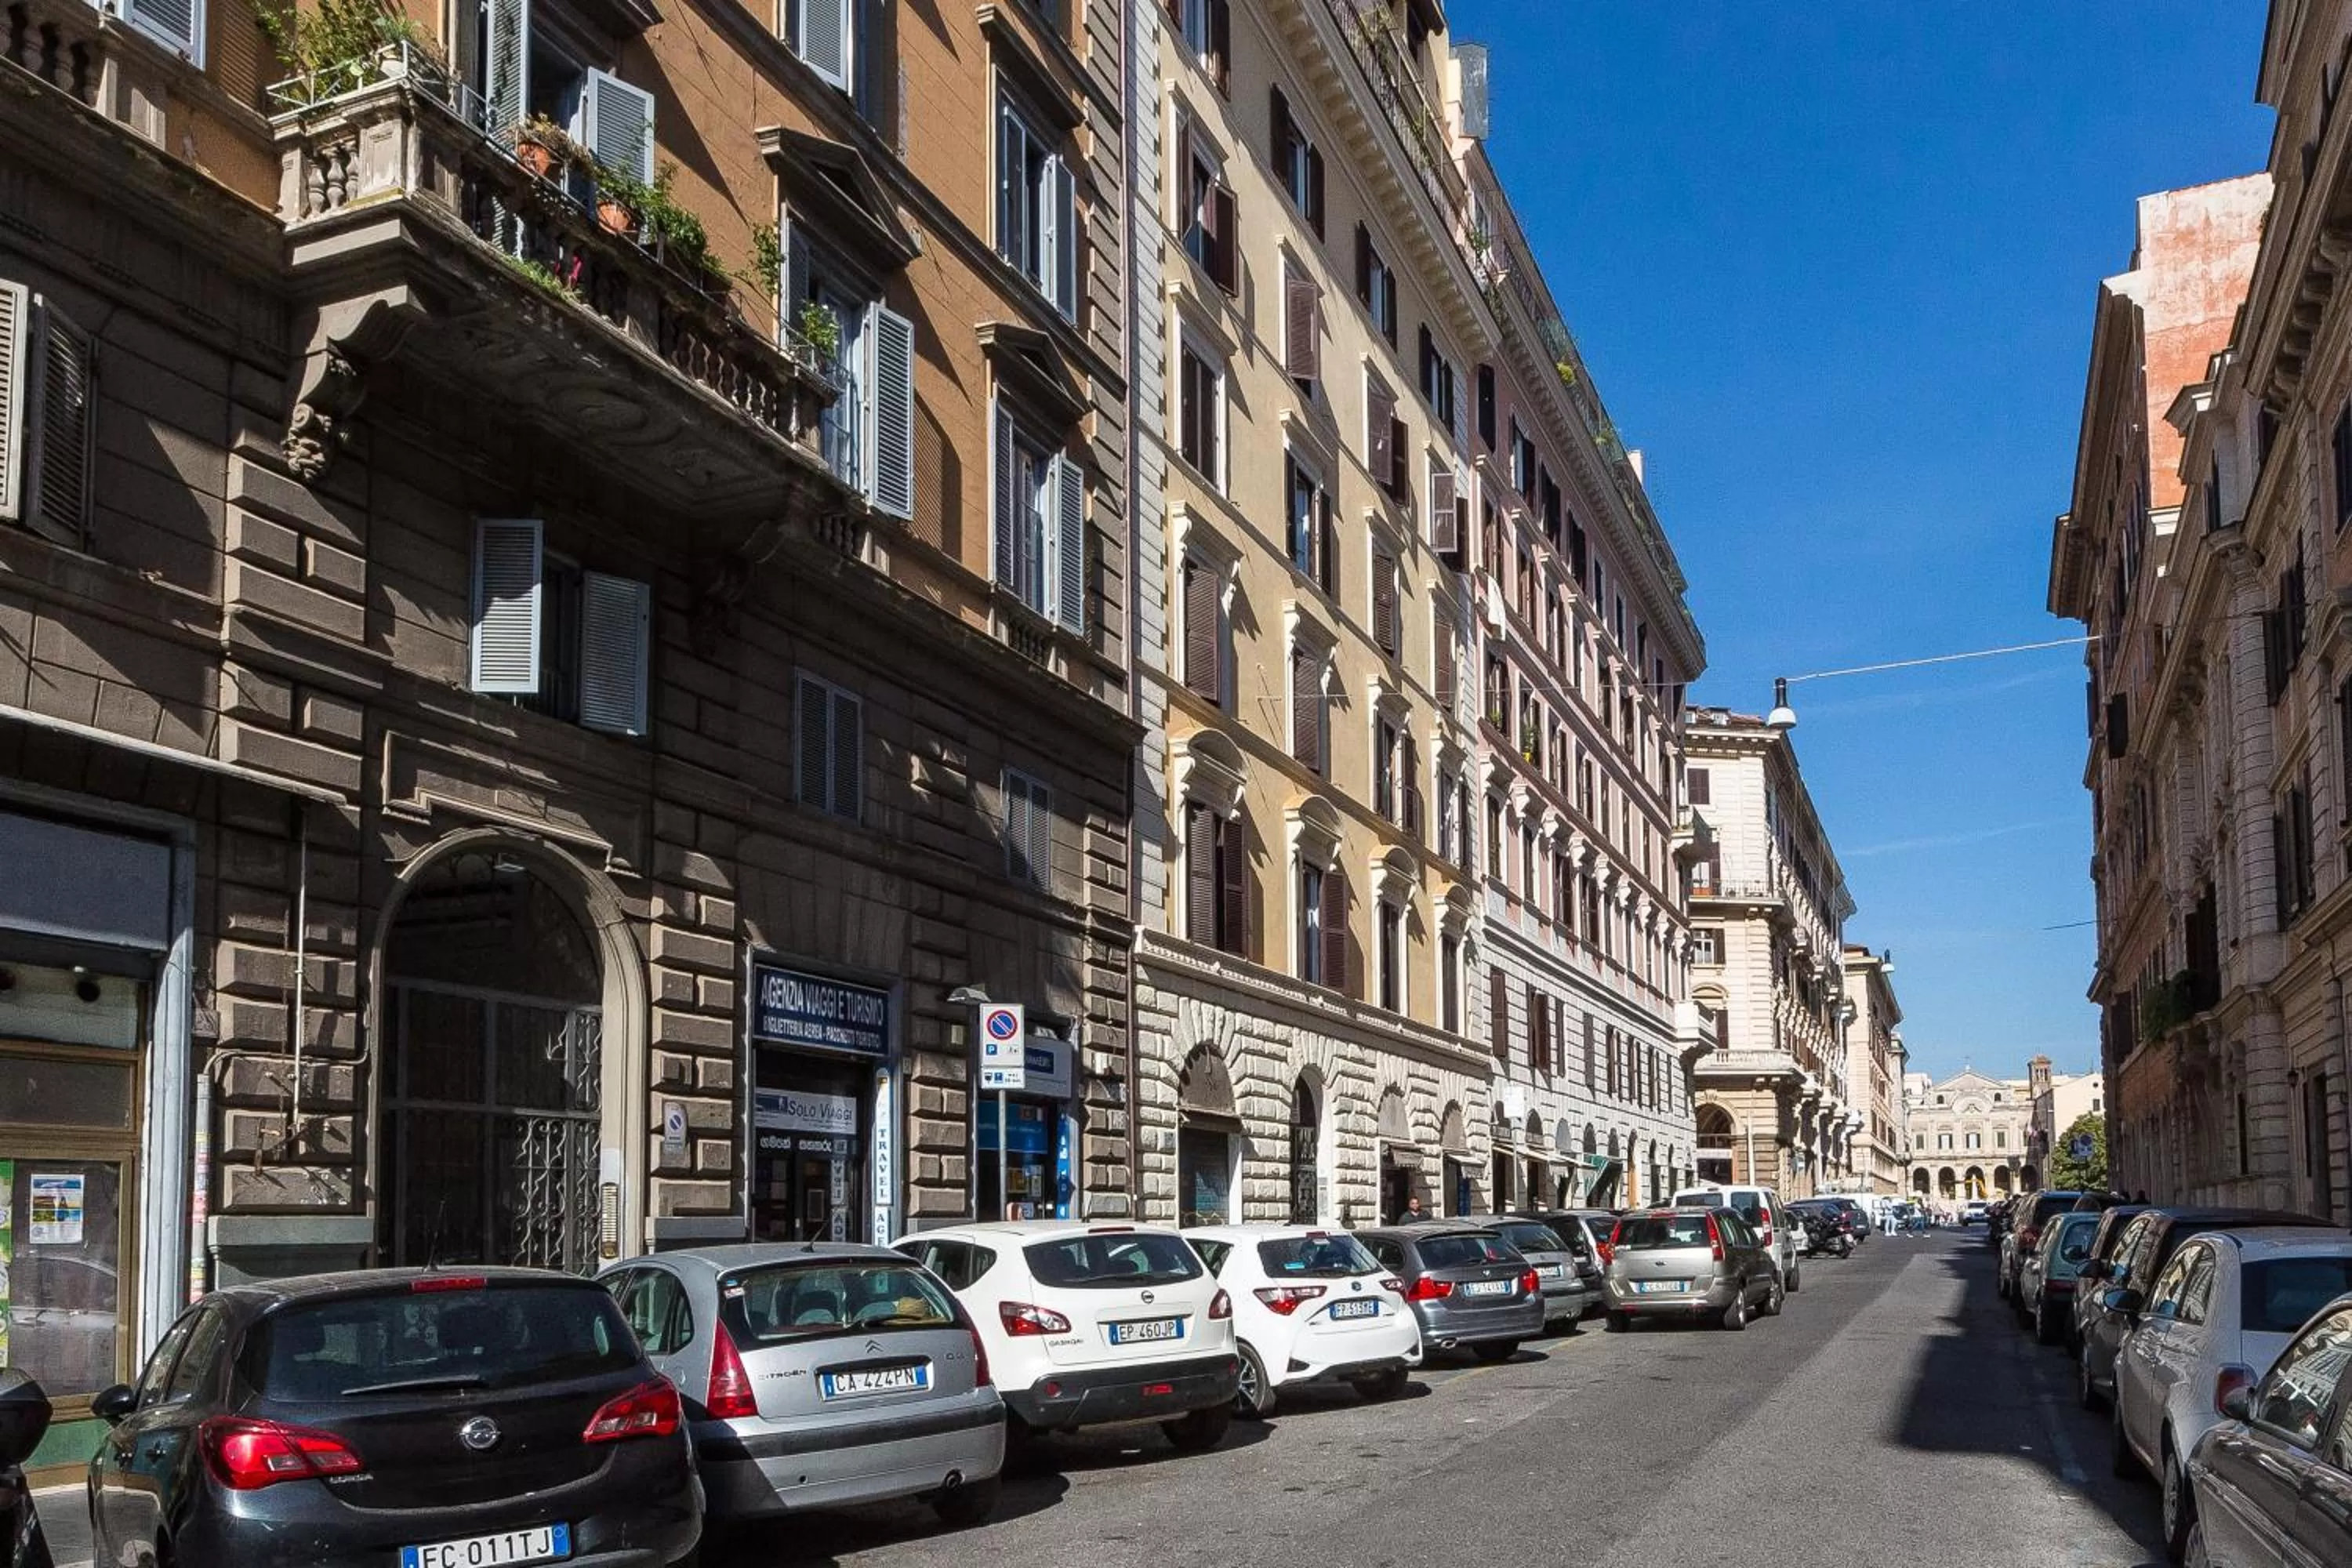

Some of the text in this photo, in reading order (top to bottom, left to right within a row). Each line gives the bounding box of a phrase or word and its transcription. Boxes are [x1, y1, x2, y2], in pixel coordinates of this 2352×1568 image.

[760, 975, 884, 1026] AGENZIA VIAGGI E TURISMO
[878, 1128, 887, 1198] TRAVEL
[1119, 1322, 1175, 1340] EP 460JP
[835, 1367, 914, 1392] CA 424PN
[423, 1530, 550, 1568] FC 011TJ
